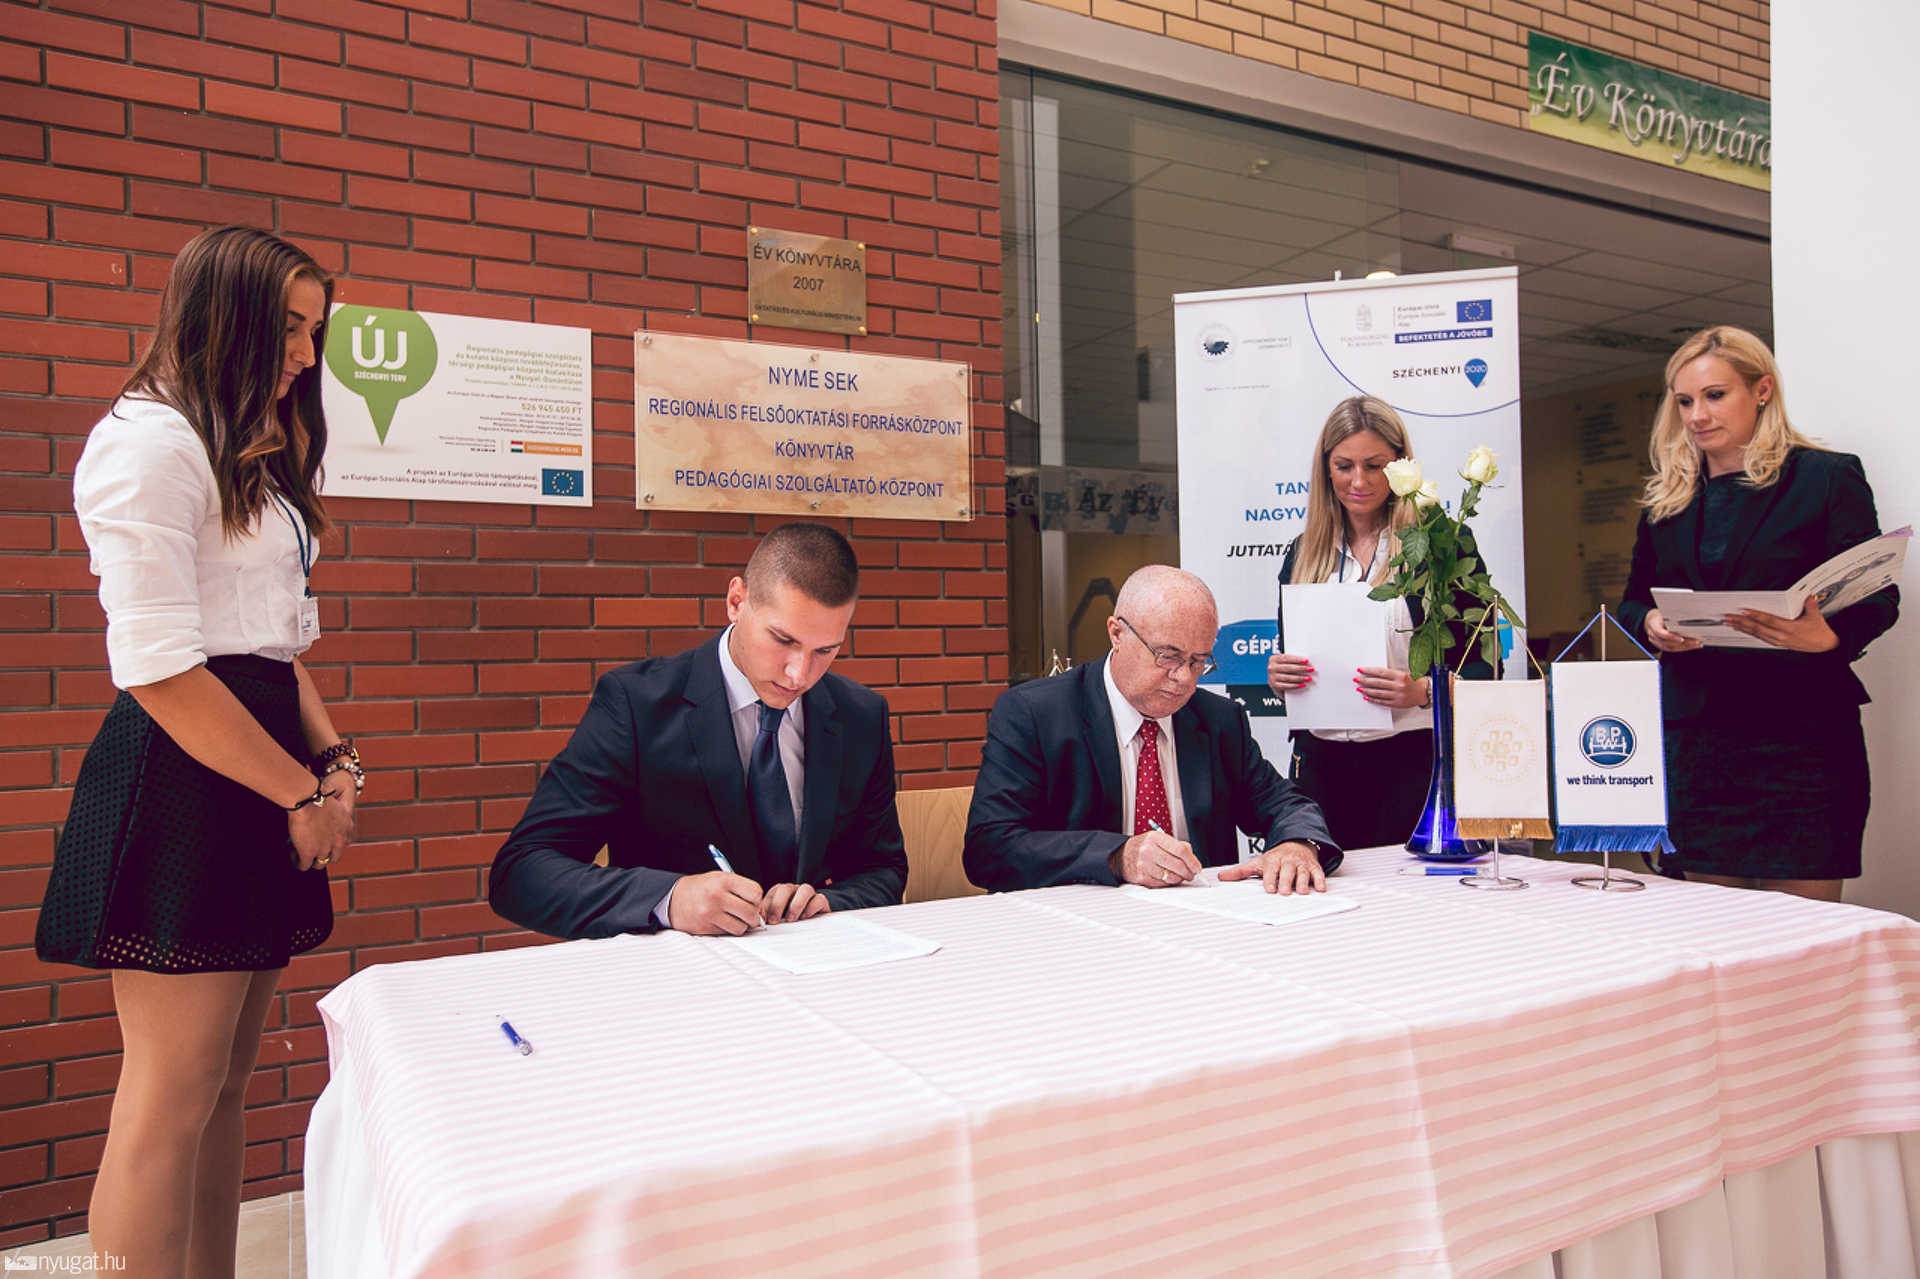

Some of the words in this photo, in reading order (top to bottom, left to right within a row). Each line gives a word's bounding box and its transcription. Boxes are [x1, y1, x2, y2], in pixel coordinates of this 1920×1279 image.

[753, 243, 773, 260] ÉV
[775, 248, 862, 272] KÖNYVTÁRA
[793, 275, 825, 292] 2007
[351, 314, 408, 371] ÚJ
[1398, 331, 1449, 343] BEFEKTETÉS
[768, 366, 819, 389] NYME
[824, 372, 859, 392] SEK
[1392, 363, 1461, 379] SZÉCHENYI
[1464, 364, 1489, 374] 2020
[648, 398, 738, 420] REGIONÁLIS
[740, 403, 850, 429] FELSŐOKTATÁSI
[852, 412, 963, 436] FORRÁSKÖZPONT
[774, 438, 855, 462] KÖNYVTÁR
[674, 469, 773, 491] PEDAGÓGIAI
[774, 473, 878, 495] SZOLGÁLTATÓ
[879, 479, 945, 498] KÖZPONT
[1567, 777, 1581, 785] we
[1582, 775, 1607, 785] think
[1608, 775, 1654, 788] transport
